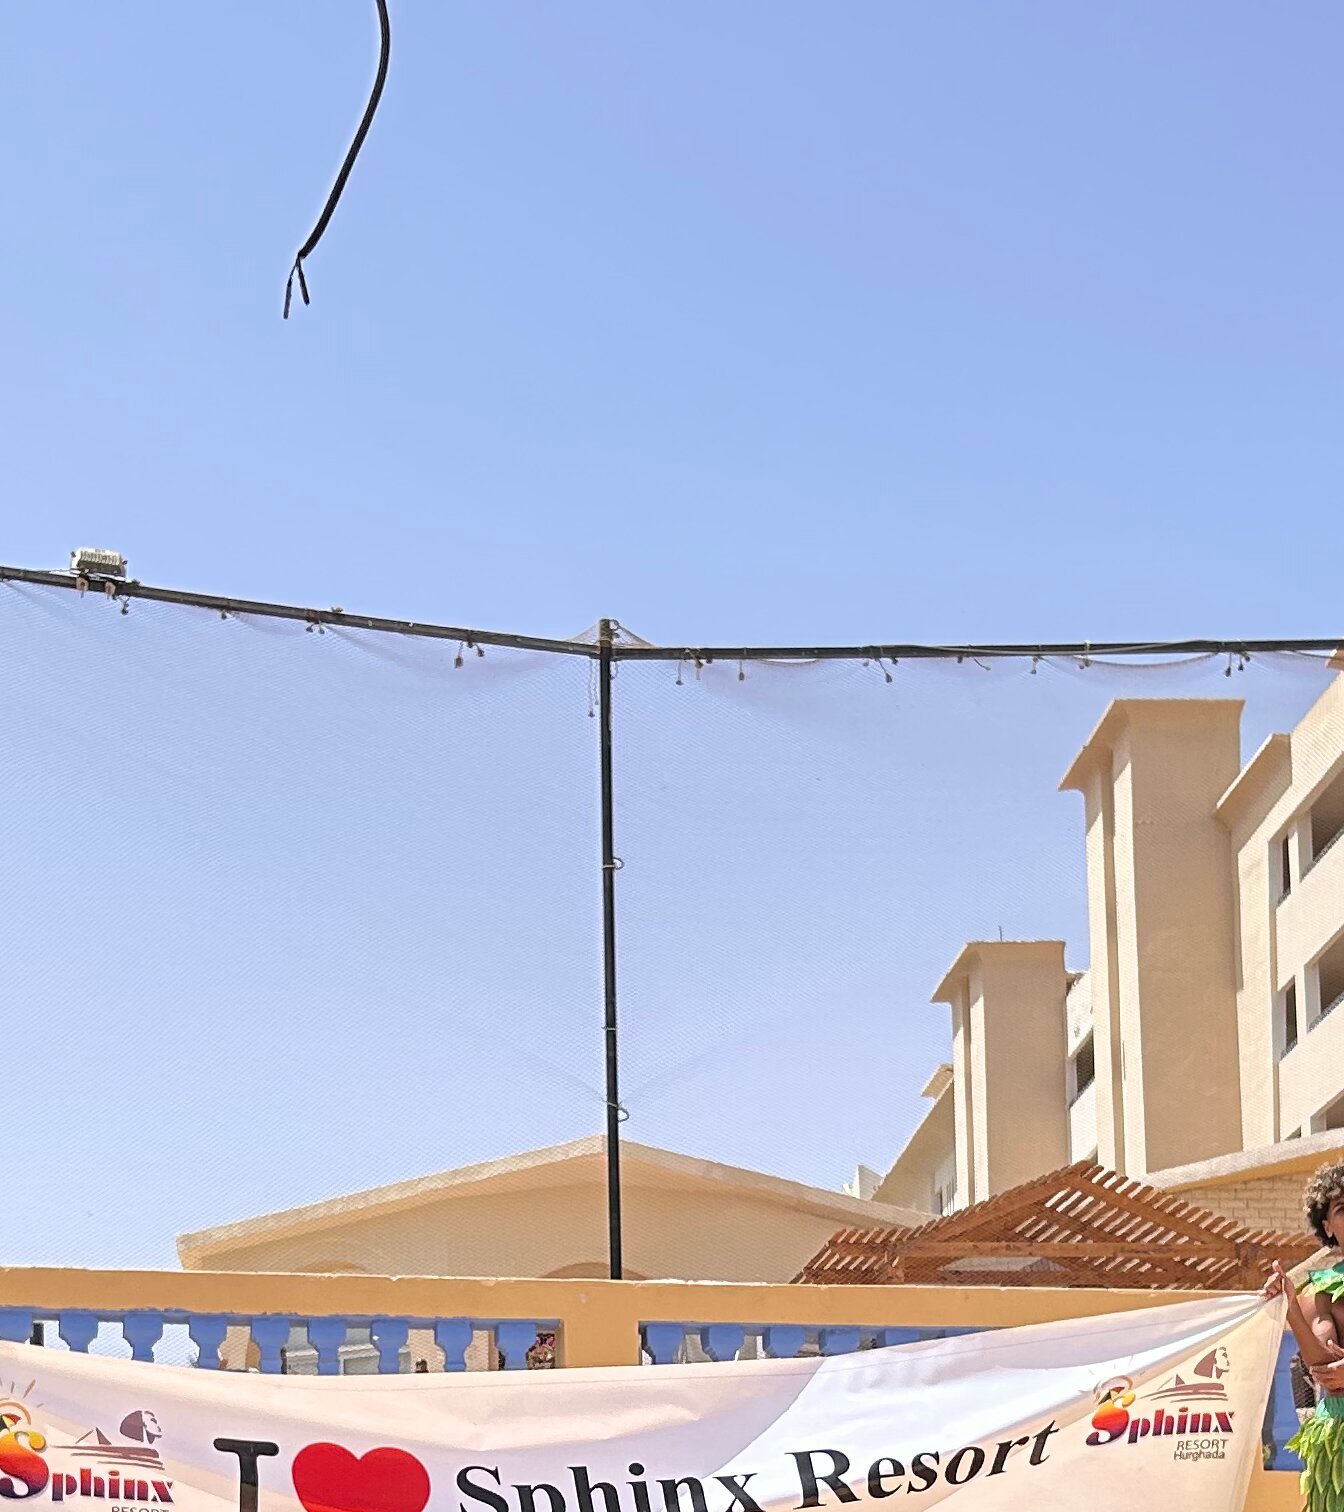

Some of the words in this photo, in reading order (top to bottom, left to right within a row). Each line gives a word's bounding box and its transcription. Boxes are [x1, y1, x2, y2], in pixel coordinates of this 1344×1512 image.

[1085, 1391, 1236, 1447] Sphinx
[1173, 1449, 1226, 1462] Hurghada
[1176, 1439, 1229, 1451] RESORT
[783, 1419, 1060, 1511] Resort
